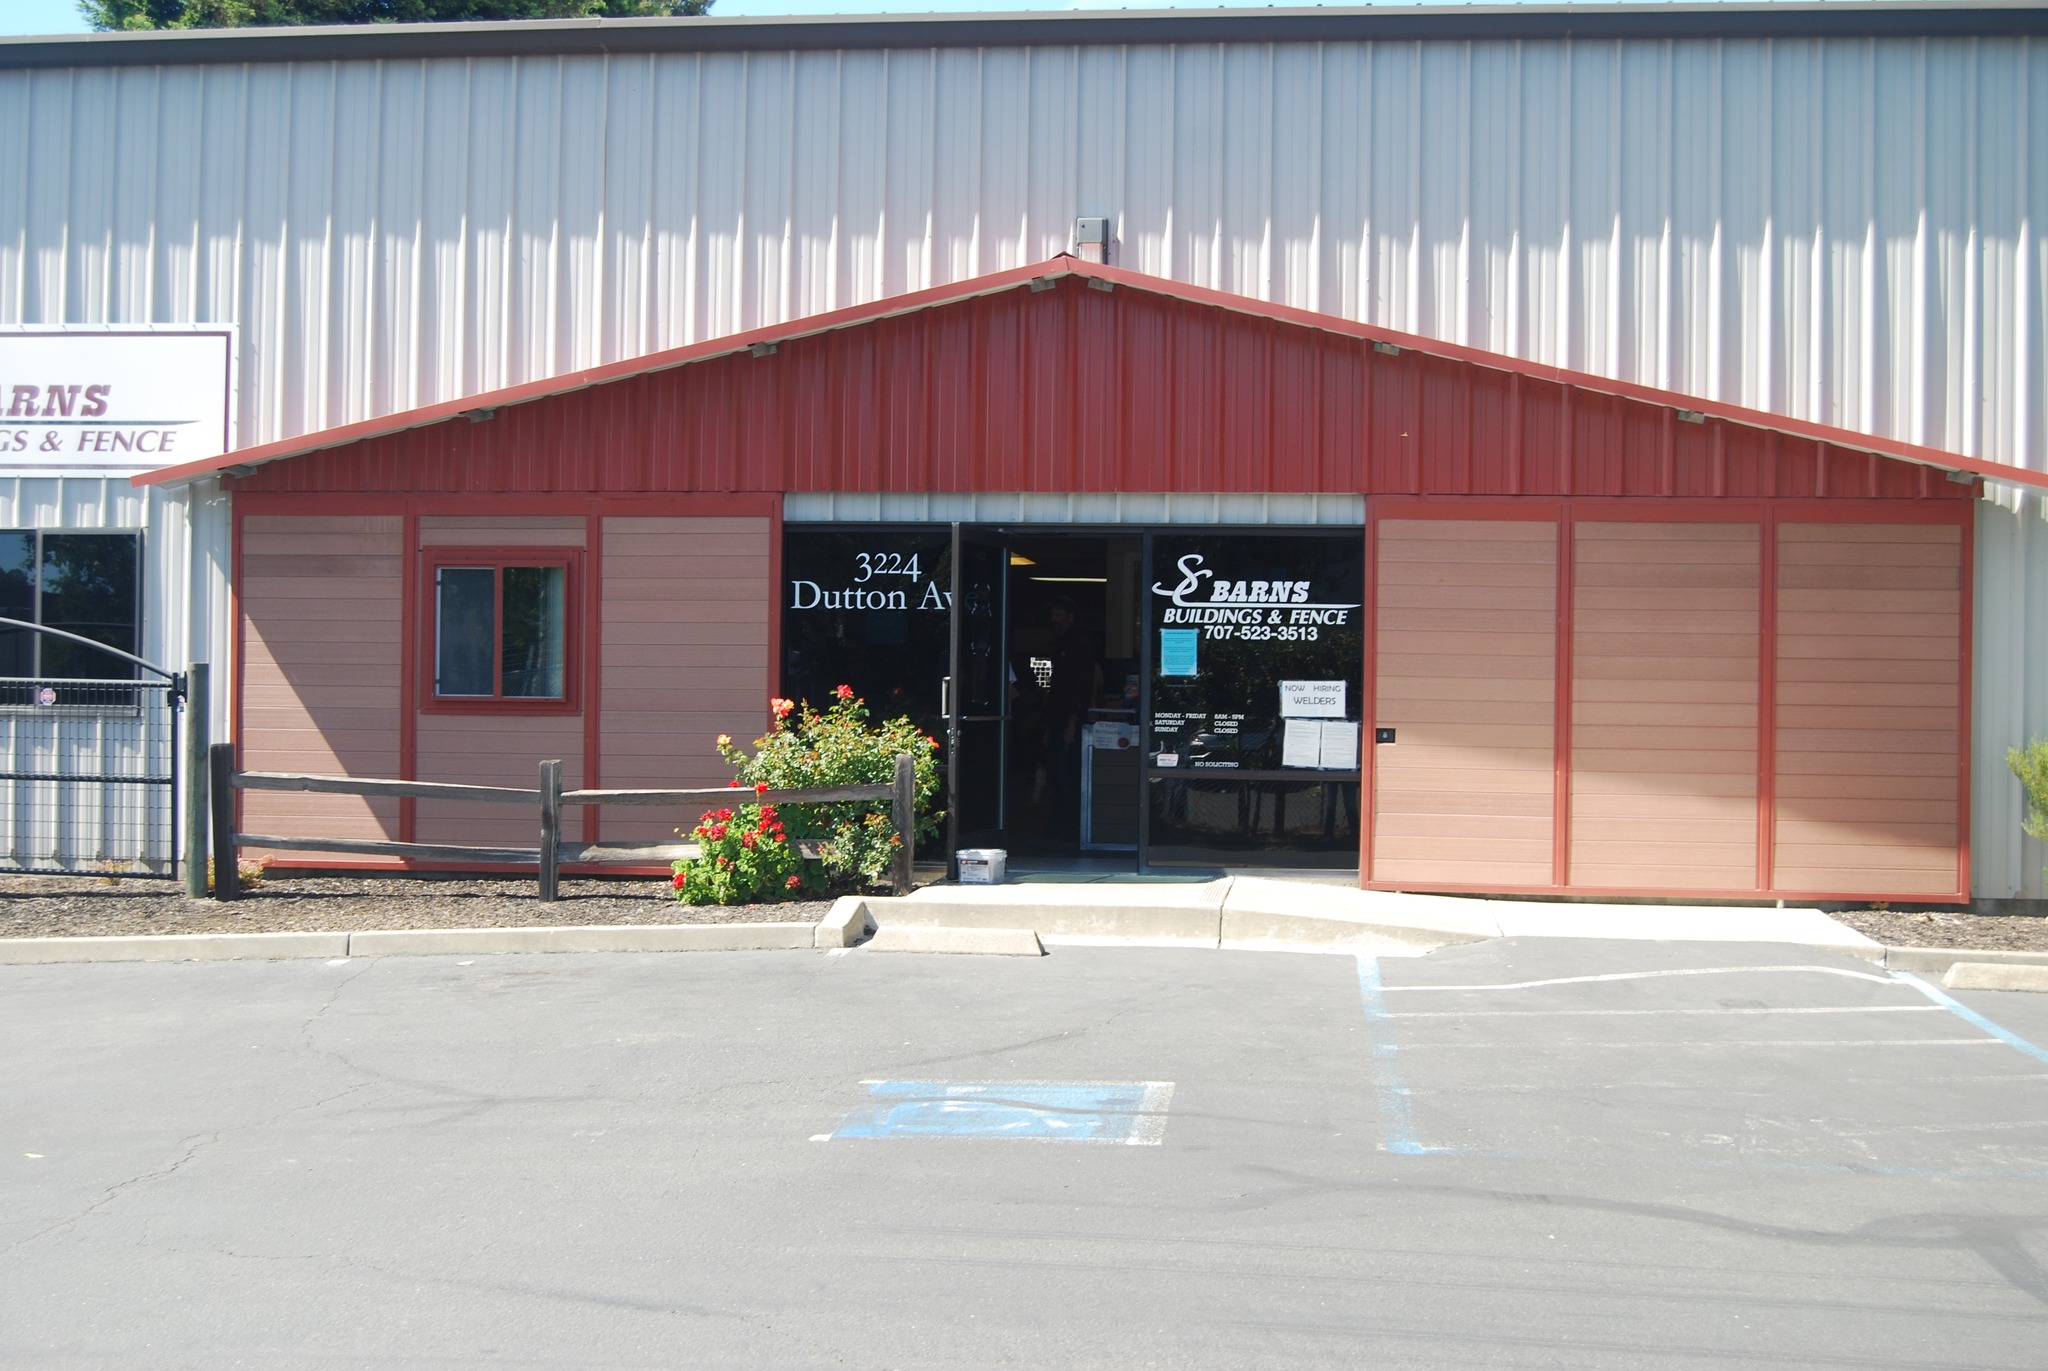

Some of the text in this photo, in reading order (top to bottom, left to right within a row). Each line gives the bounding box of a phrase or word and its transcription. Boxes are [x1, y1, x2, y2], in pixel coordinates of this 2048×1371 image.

[0, 384, 111, 417] RNS
[39, 430, 63, 452] &
[77, 430, 177, 453] FENCE
[854, 552, 922, 583] 3224
[790, 580, 908, 610] Dutton
[1210, 580, 1311, 603] BARNS
[1163, 608, 1349, 626] BUILDINGS & FENCE
[1204, 625, 1318, 641] 707-523-3513
[1284, 684, 1342, 693] NOW HIRING
[1293, 696, 1337, 705] WELDERS
